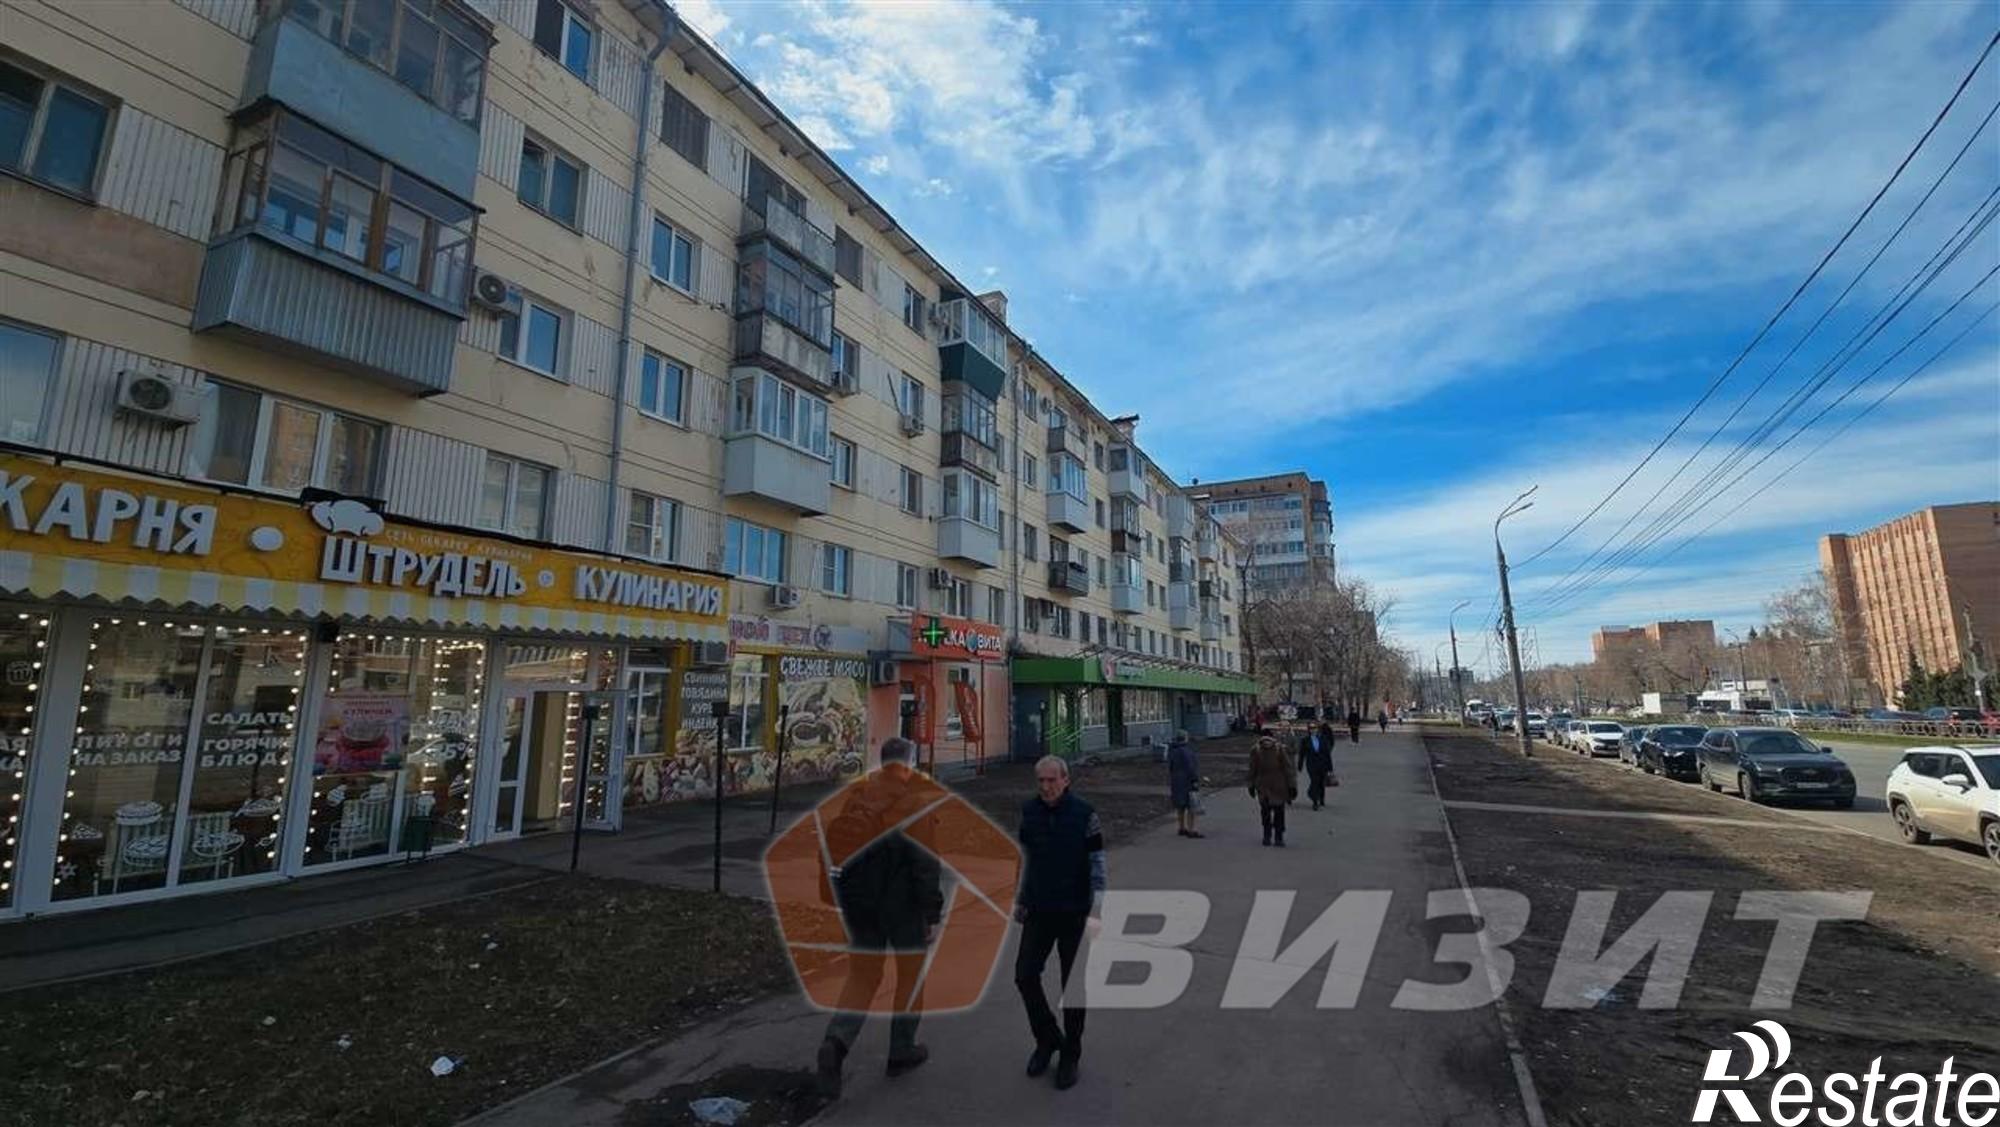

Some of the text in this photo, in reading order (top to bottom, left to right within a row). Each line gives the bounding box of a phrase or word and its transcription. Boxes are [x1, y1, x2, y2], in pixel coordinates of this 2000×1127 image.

[320, 535, 527, 598] ШТРУДЕЛЬ
[575, 565, 723, 616] КУЛИНАРИЯ
[977, 633, 1002, 651] ВИТА
[780, 656, 865, 679] СВЕЖЕЕ МЯСО
[680, 686, 728, 699] ГОВЯДИНА
[78, 732, 182, 749] ПИРОГИ
[75, 749, 181, 767] НА ЗАКАЗ
